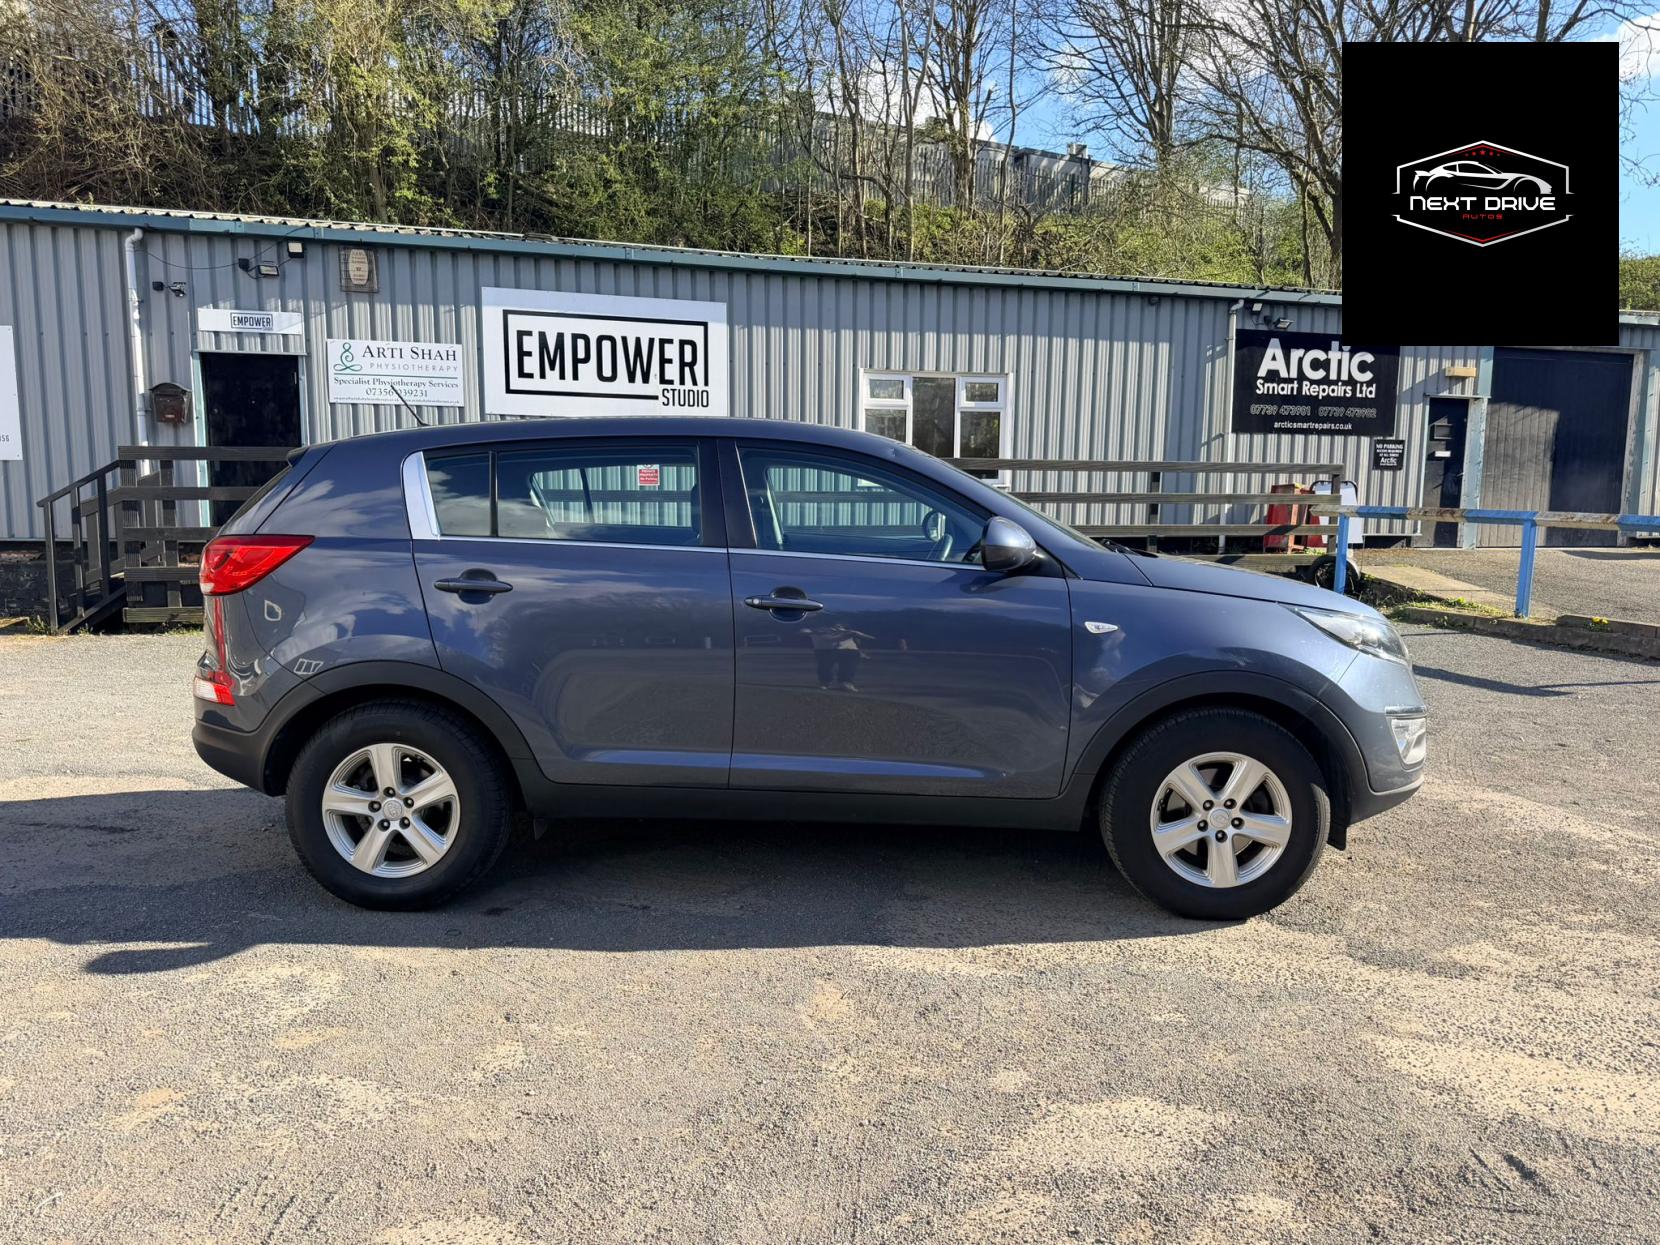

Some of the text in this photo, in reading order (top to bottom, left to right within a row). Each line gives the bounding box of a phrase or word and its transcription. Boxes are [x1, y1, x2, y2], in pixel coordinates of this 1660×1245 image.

[233, 316, 271, 327] EMPOWER
[362, 344, 457, 361] ARTI SHAH
[516, 329, 698, 387] EMPOWER
[369, 362, 458, 372] PHYSIOTHERAPY
[1256, 338, 1376, 382] Arctic
[333, 377, 459, 388] Specialist Physiotherapy Services
[1256, 379, 1376, 400] Smart Repairs Ltd
[661, 388, 709, 408] STUDIO
[1273, 420, 1352, 430] arcticsmartrepairs.co.uk
[0, 434, 10, 442] 56
